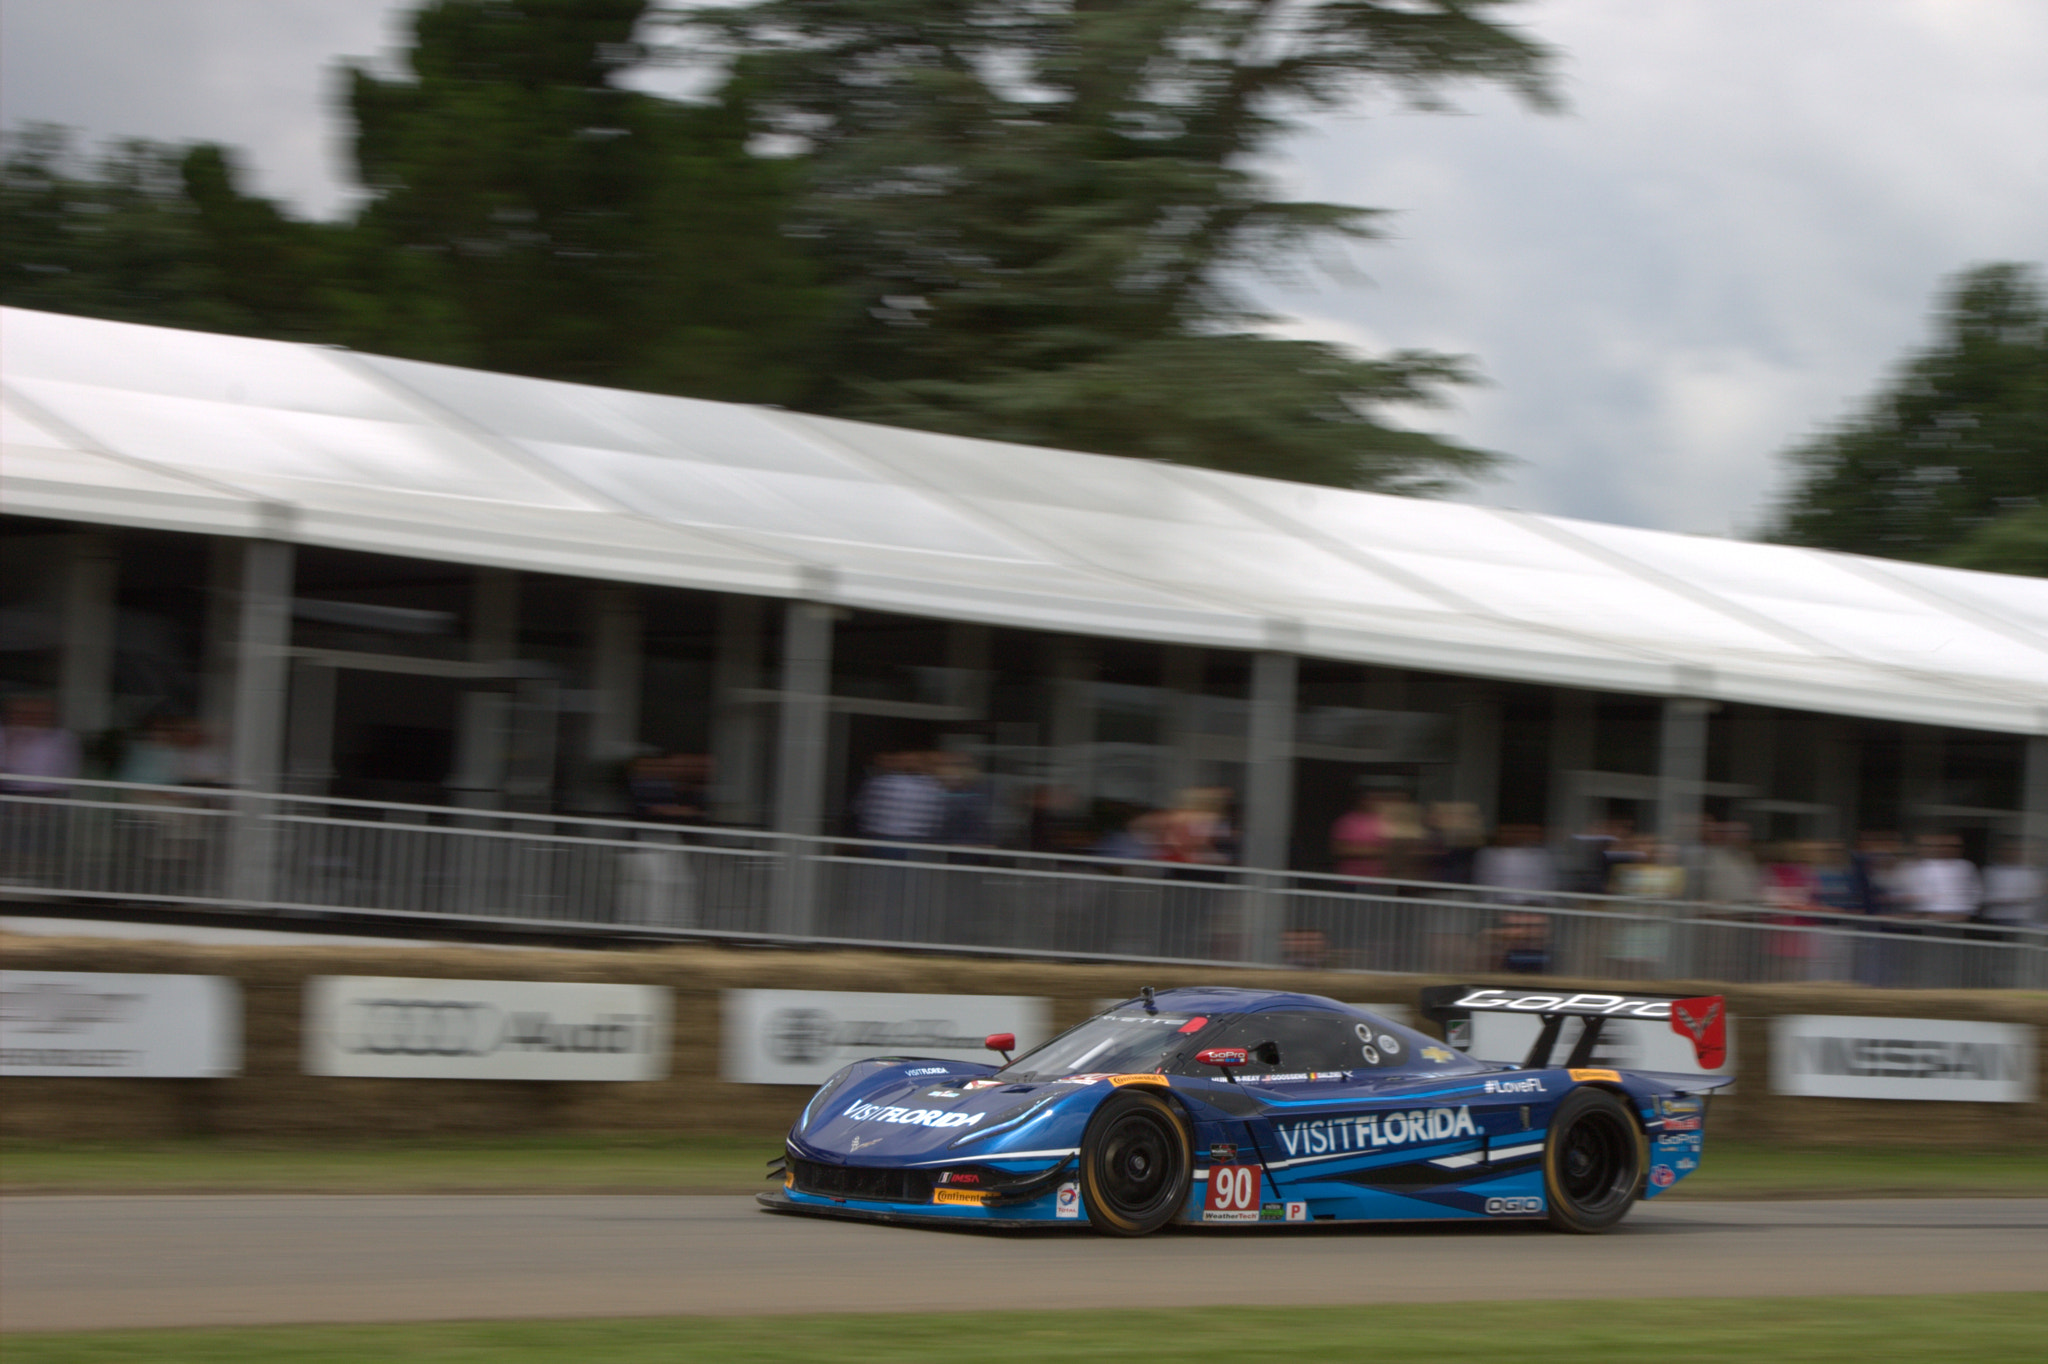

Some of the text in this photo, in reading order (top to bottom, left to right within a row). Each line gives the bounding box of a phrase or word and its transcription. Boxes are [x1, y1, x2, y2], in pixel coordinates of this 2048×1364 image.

[1454, 990, 1672, 1017] GoPro
[1484, 1078, 1548, 1093] #LoveFL
[950, 1173, 980, 1183] IMSA
[1215, 1167, 1252, 1209] 90
[937, 1190, 989, 1203] Continent
[1291, 1204, 1300, 1219] P
[1484, 1197, 1543, 1214] OGIO
